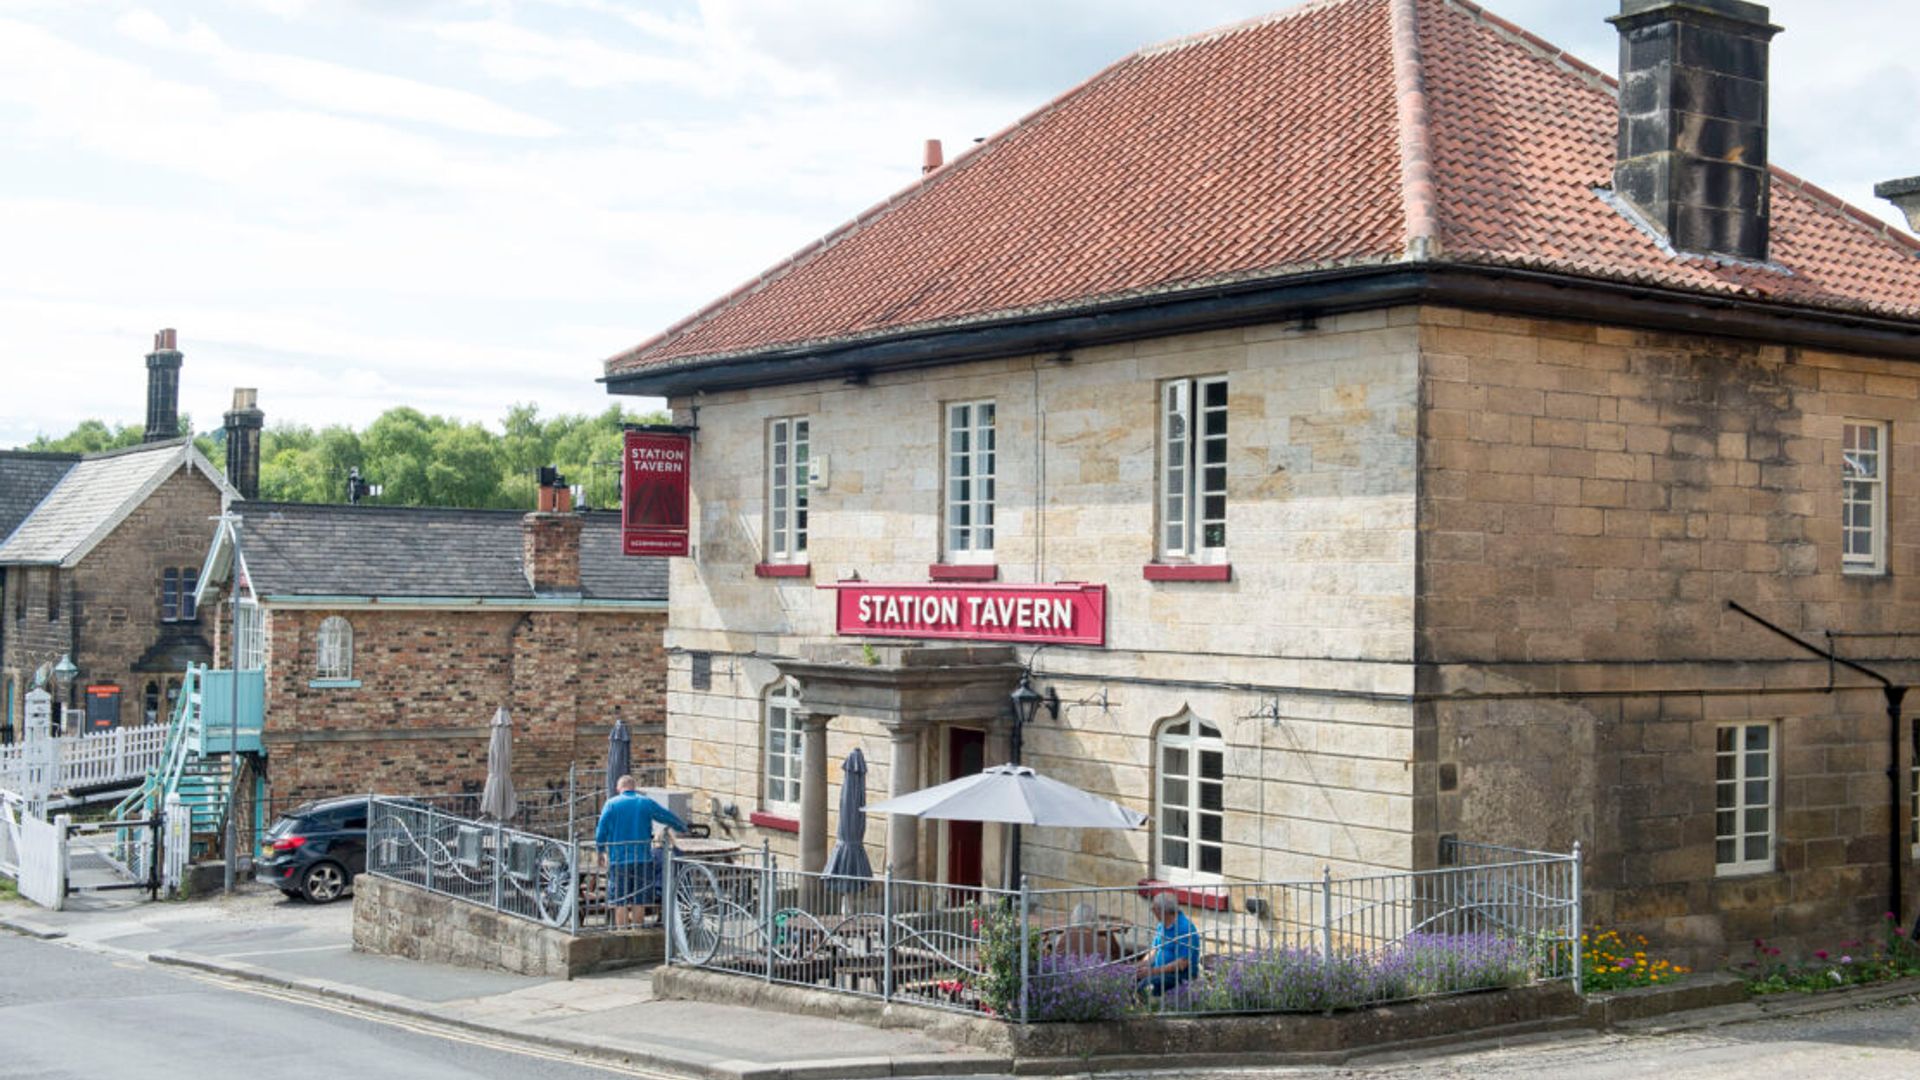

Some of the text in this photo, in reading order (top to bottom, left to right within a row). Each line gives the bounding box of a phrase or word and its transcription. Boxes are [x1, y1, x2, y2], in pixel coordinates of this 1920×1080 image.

[632, 448, 684, 461] STATION
[633, 460, 682, 472] TAVERN
[858, 595, 1072, 629] STATION TAVERN
